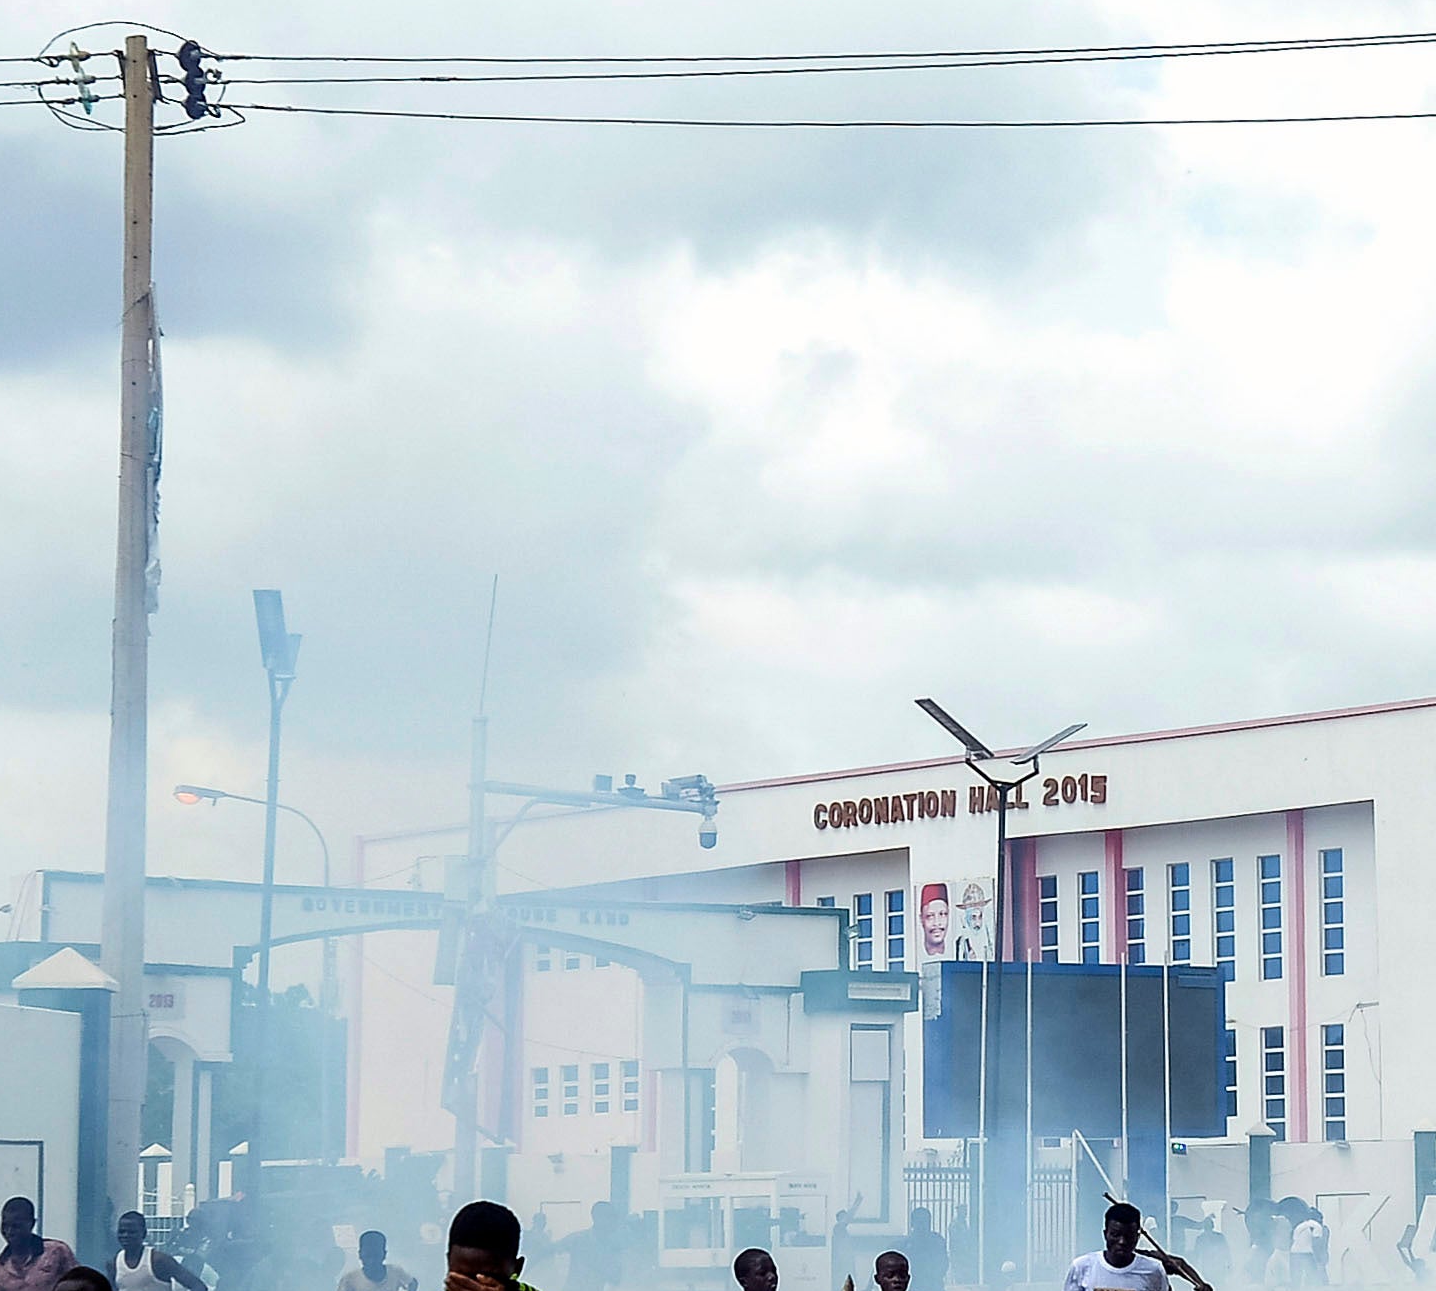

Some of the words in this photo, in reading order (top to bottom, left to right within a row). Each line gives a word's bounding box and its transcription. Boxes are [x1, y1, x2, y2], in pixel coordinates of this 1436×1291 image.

[814, 789, 957, 830] CORONATION
[969, 784, 1029, 815] HAL
[1042, 773, 1107, 807] 2015
[302, 896, 443, 918] GOVERNMENT
[500, 907, 557, 924] OUSE
[580, 909, 630, 926] KANO
